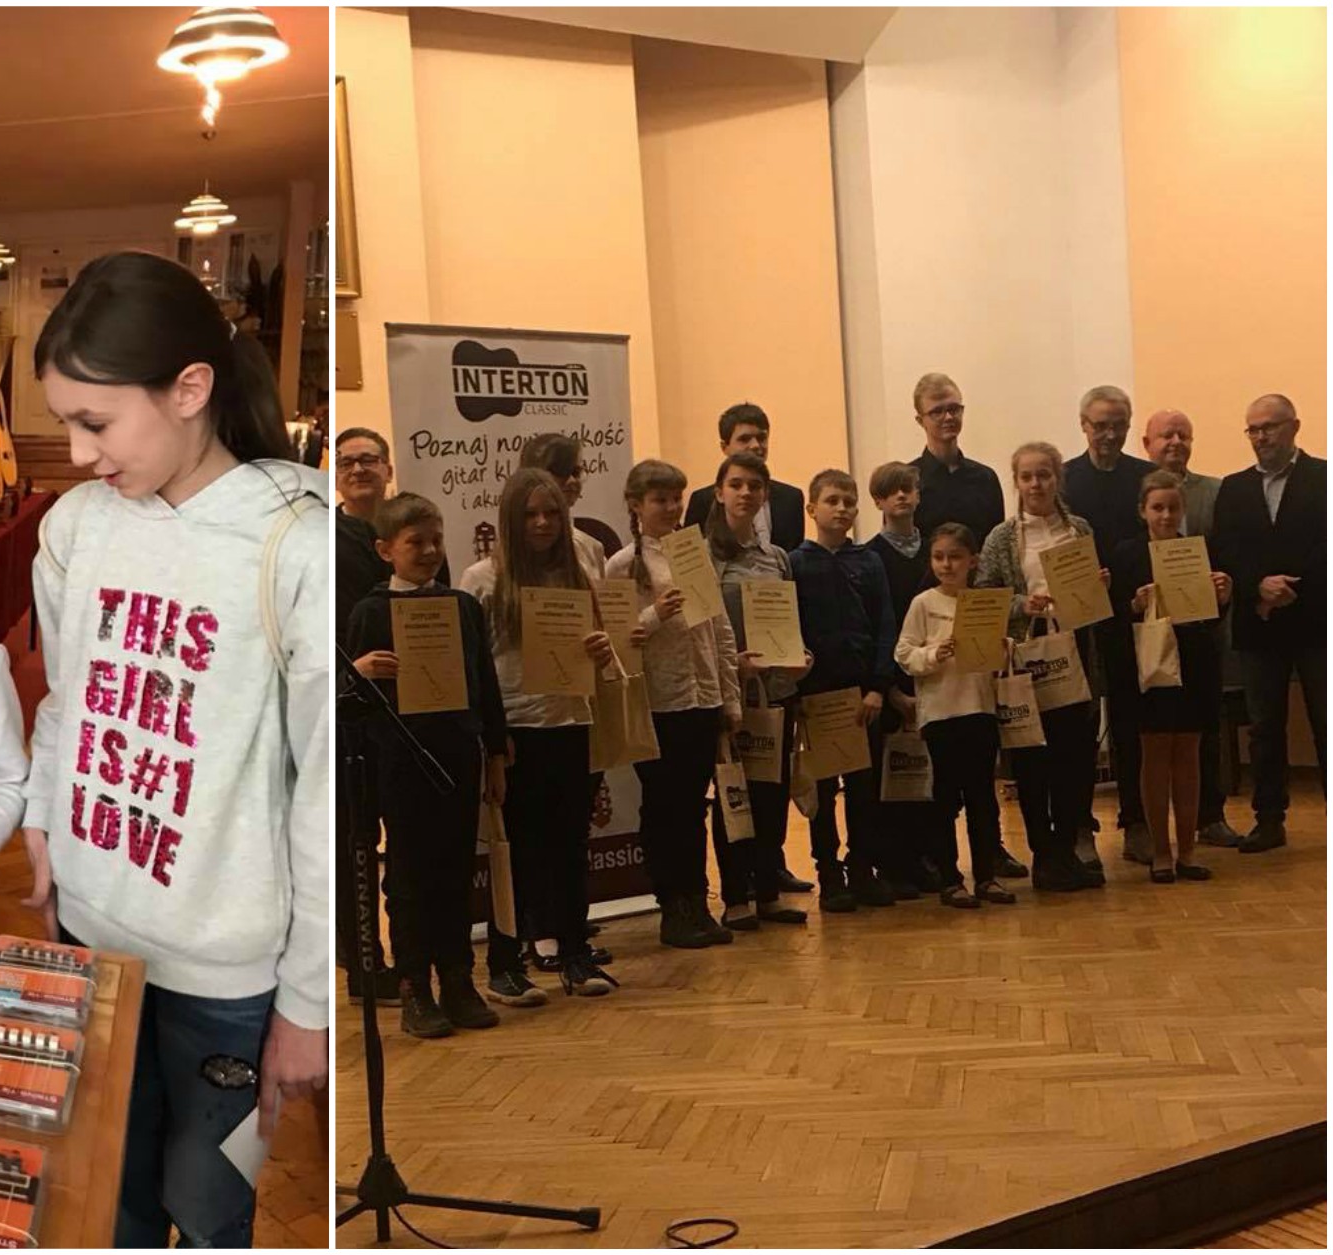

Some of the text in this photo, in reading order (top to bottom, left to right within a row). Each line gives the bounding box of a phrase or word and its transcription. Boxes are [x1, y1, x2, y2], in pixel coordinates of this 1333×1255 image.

[452, 367, 590, 396] INTERTON
[524, 404, 569, 416] CLASSIC
[409, 429, 489, 466] Poznaj
[442, 464, 488, 496] gitar
[99, 587, 219, 672] THIS
[85, 658, 198, 749] GIRL
[71, 783, 183, 888] LOVE
